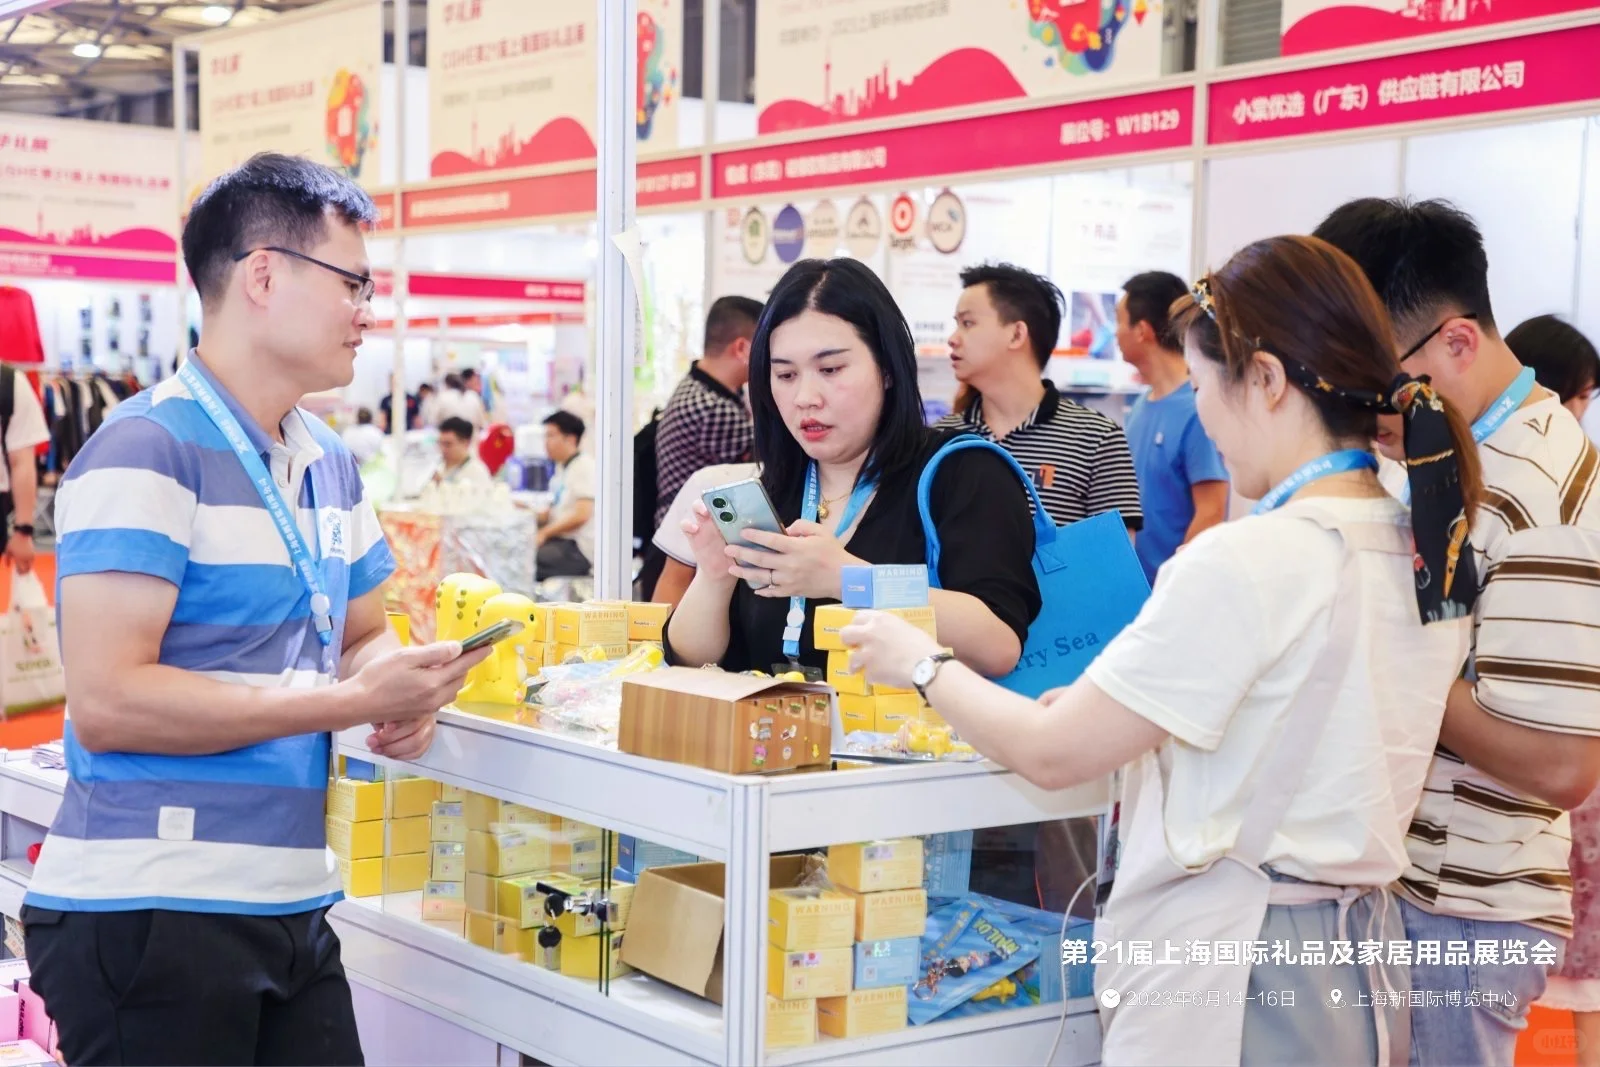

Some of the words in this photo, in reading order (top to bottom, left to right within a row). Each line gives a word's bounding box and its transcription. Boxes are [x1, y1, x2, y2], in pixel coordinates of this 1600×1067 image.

[877, 567, 924, 577] WARNING
[584, 611, 625, 619] WARNING
[1053, 631, 1101, 657] Sea
[871, 894, 923, 908] WARNING
[795, 903, 851, 915] WARNING
[854, 989, 904, 1004] WARNING
